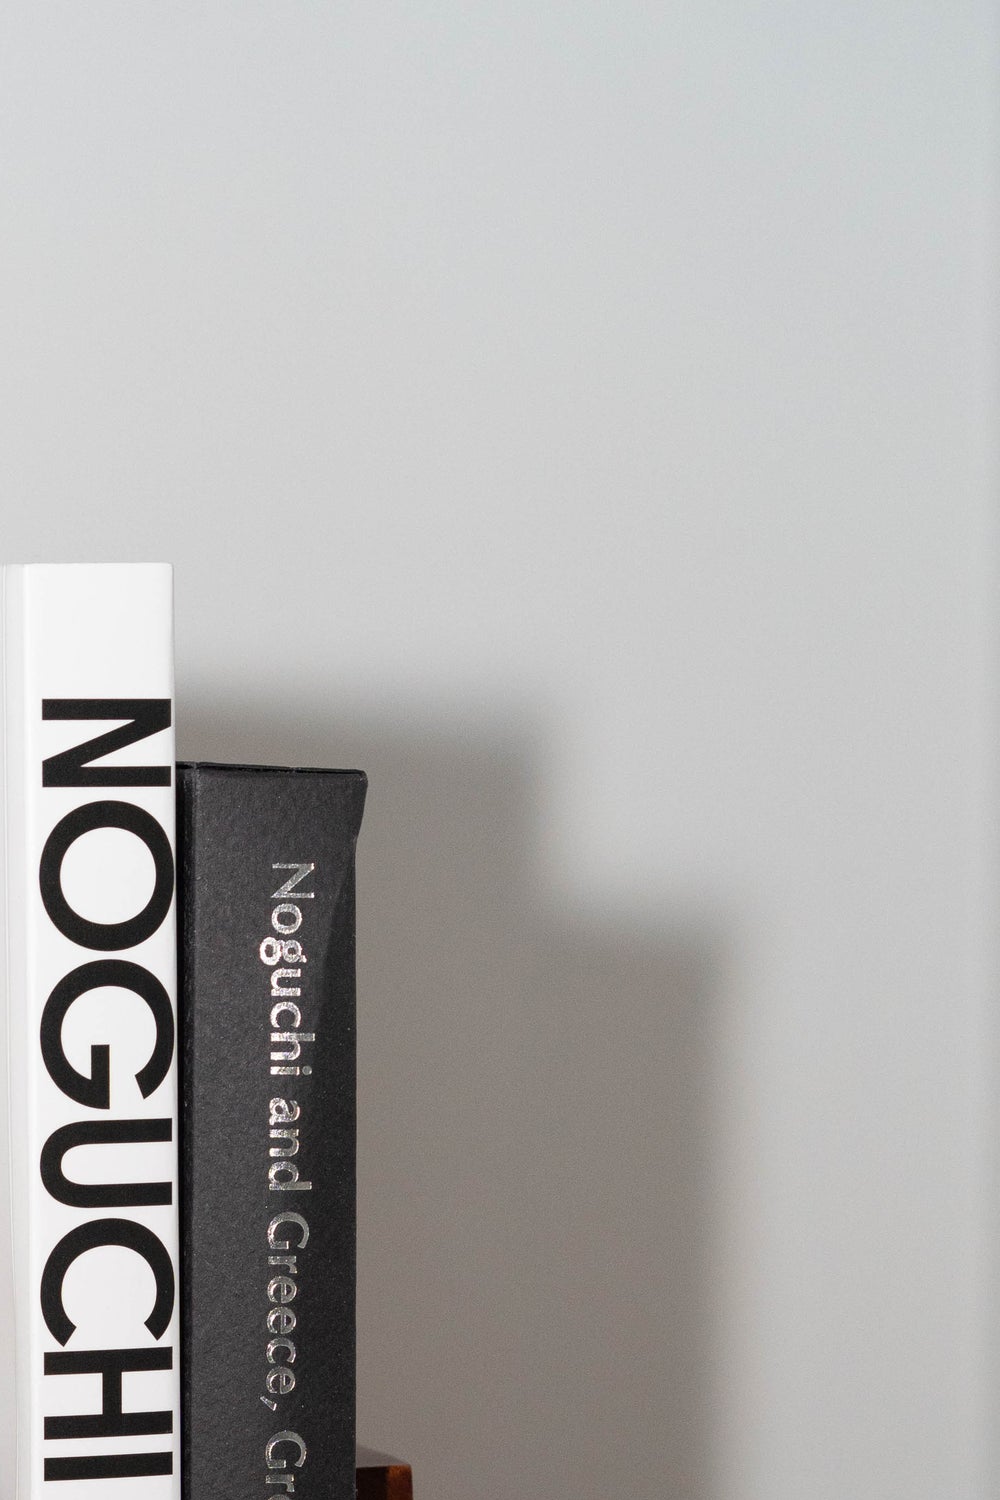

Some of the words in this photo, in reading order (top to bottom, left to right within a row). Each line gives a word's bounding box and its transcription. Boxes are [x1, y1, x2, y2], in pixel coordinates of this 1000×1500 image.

[259, 862, 316, 1077] Noguchi
[38, 698, 176, 1482] NOGUCHI
[268, 1097, 313, 1191] and
[259, 1210, 311, 1412] Greece,
